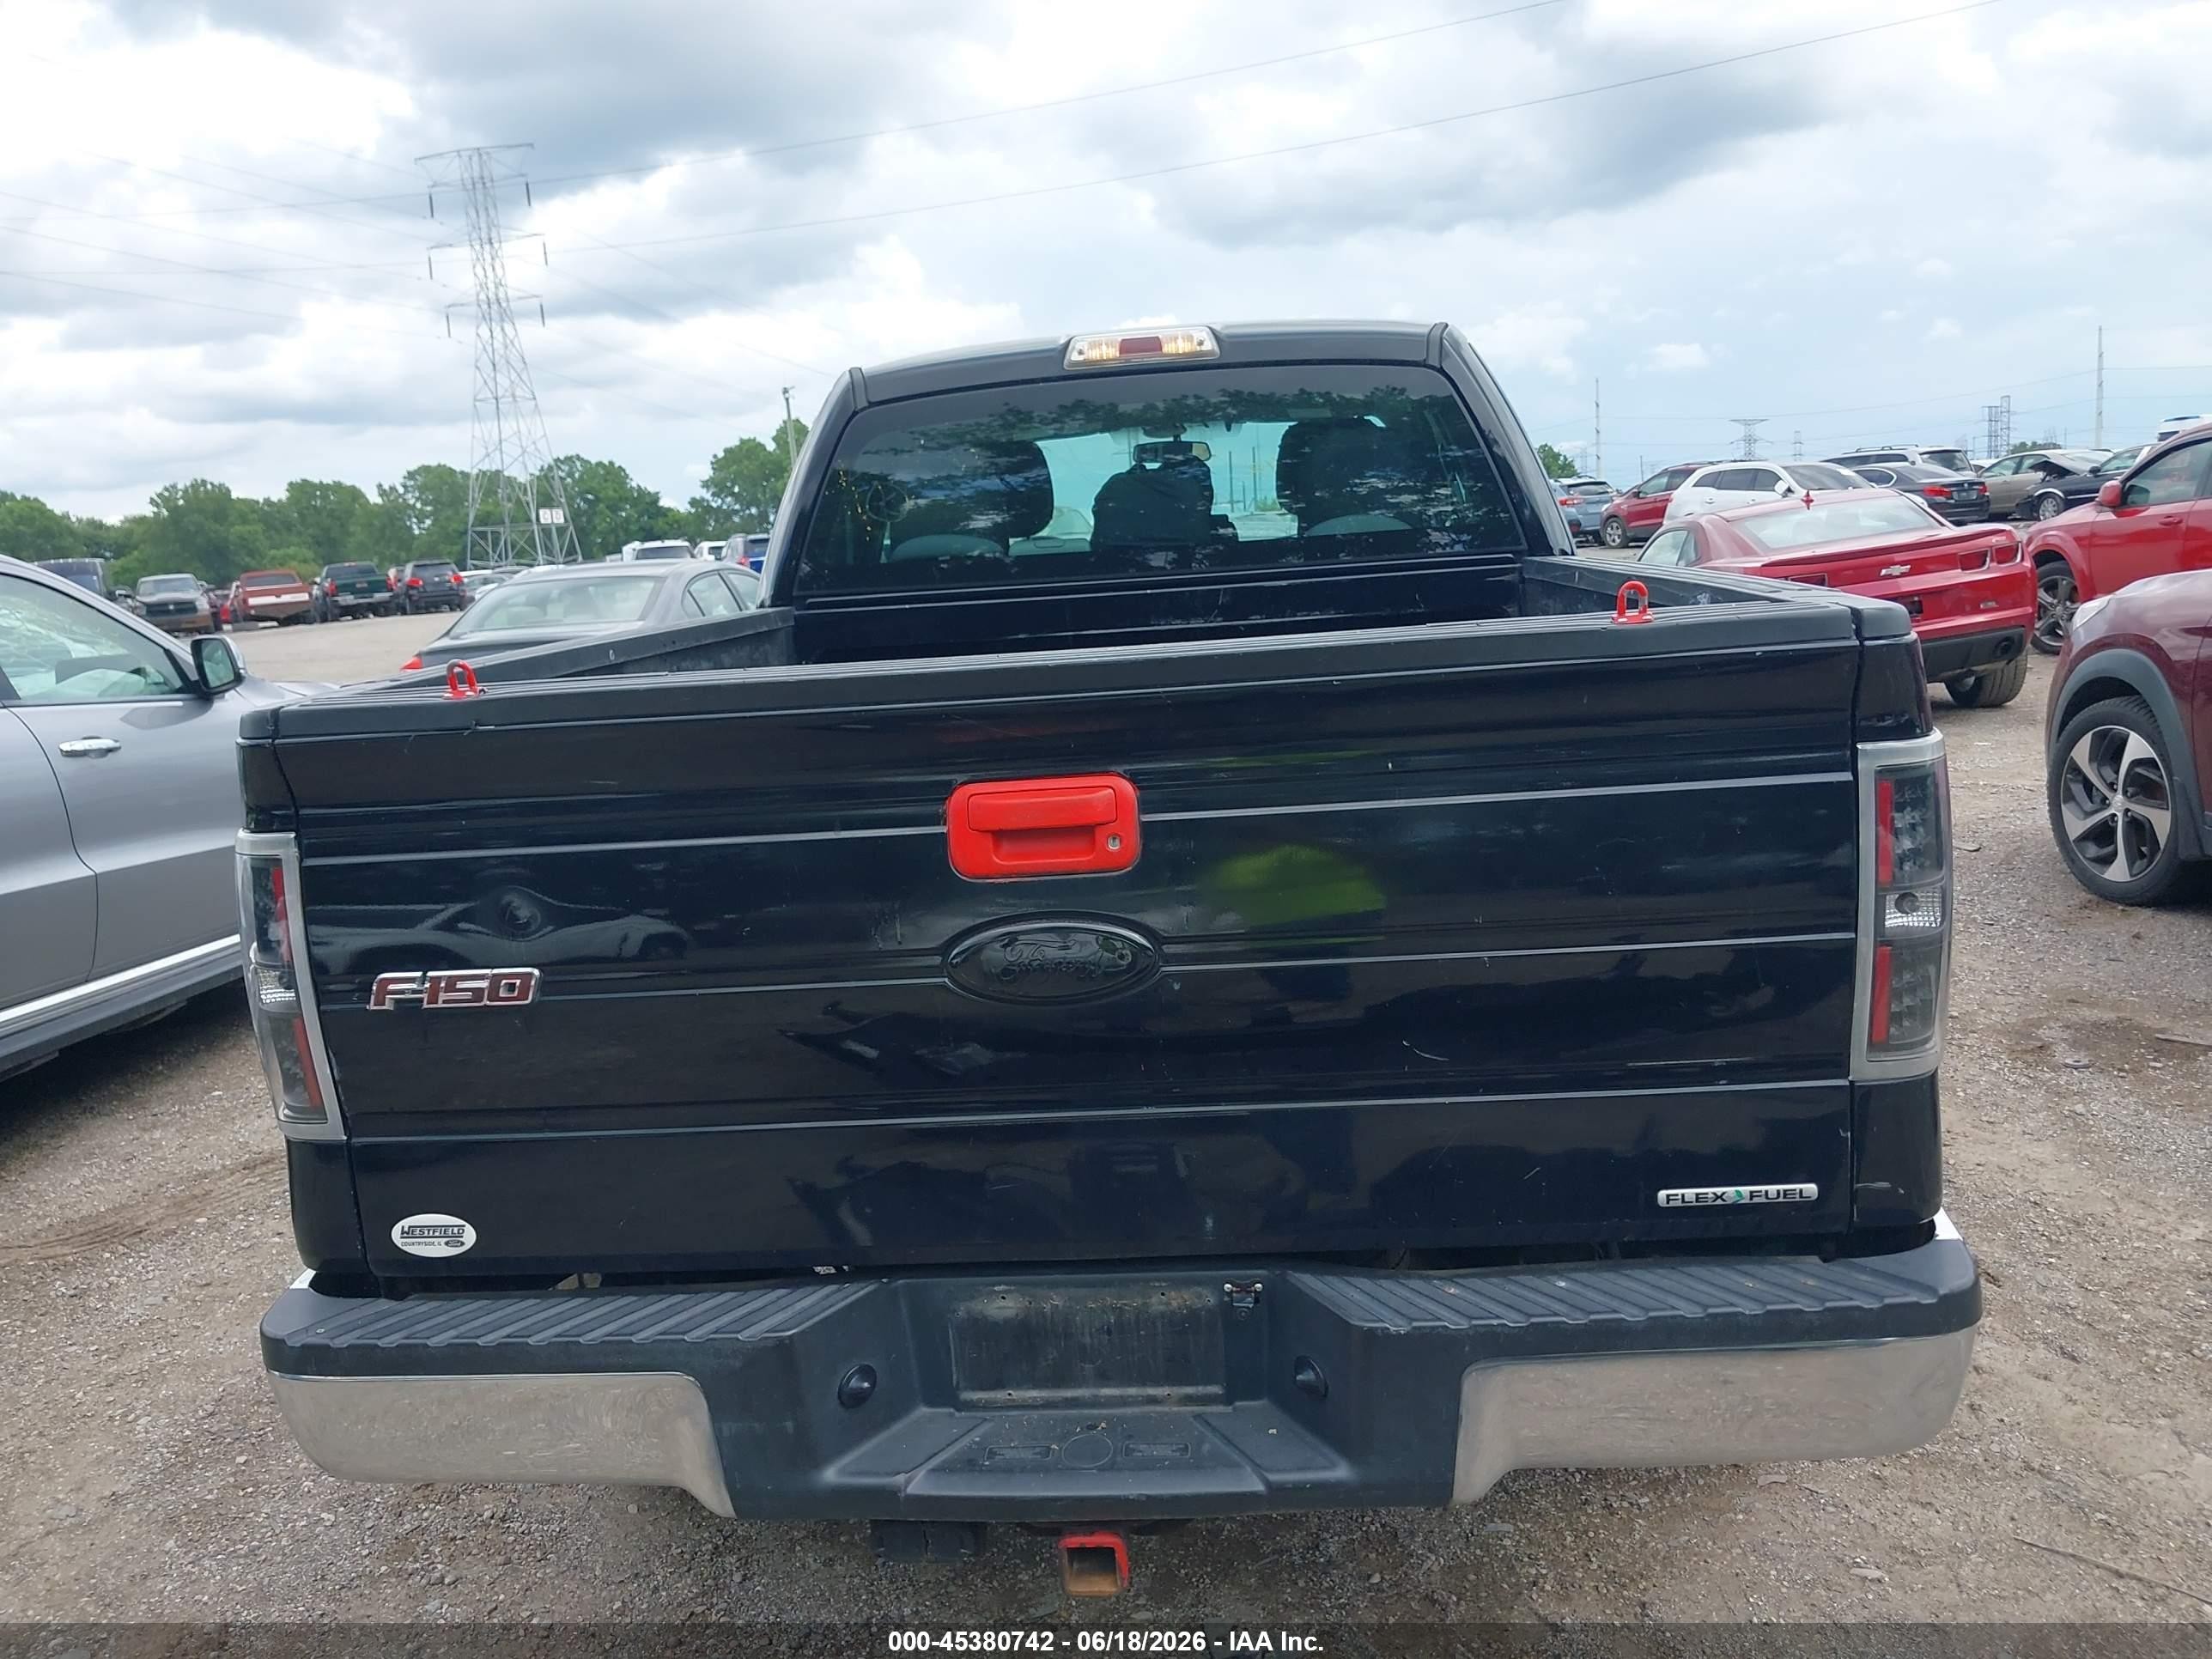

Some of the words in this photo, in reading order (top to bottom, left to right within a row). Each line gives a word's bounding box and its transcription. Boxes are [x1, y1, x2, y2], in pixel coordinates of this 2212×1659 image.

[1665, 1191, 1727, 1205] FLEX
[1749, 1188, 1812, 1201] FUEL
[400, 1224, 465, 1236] WESTFIELD
